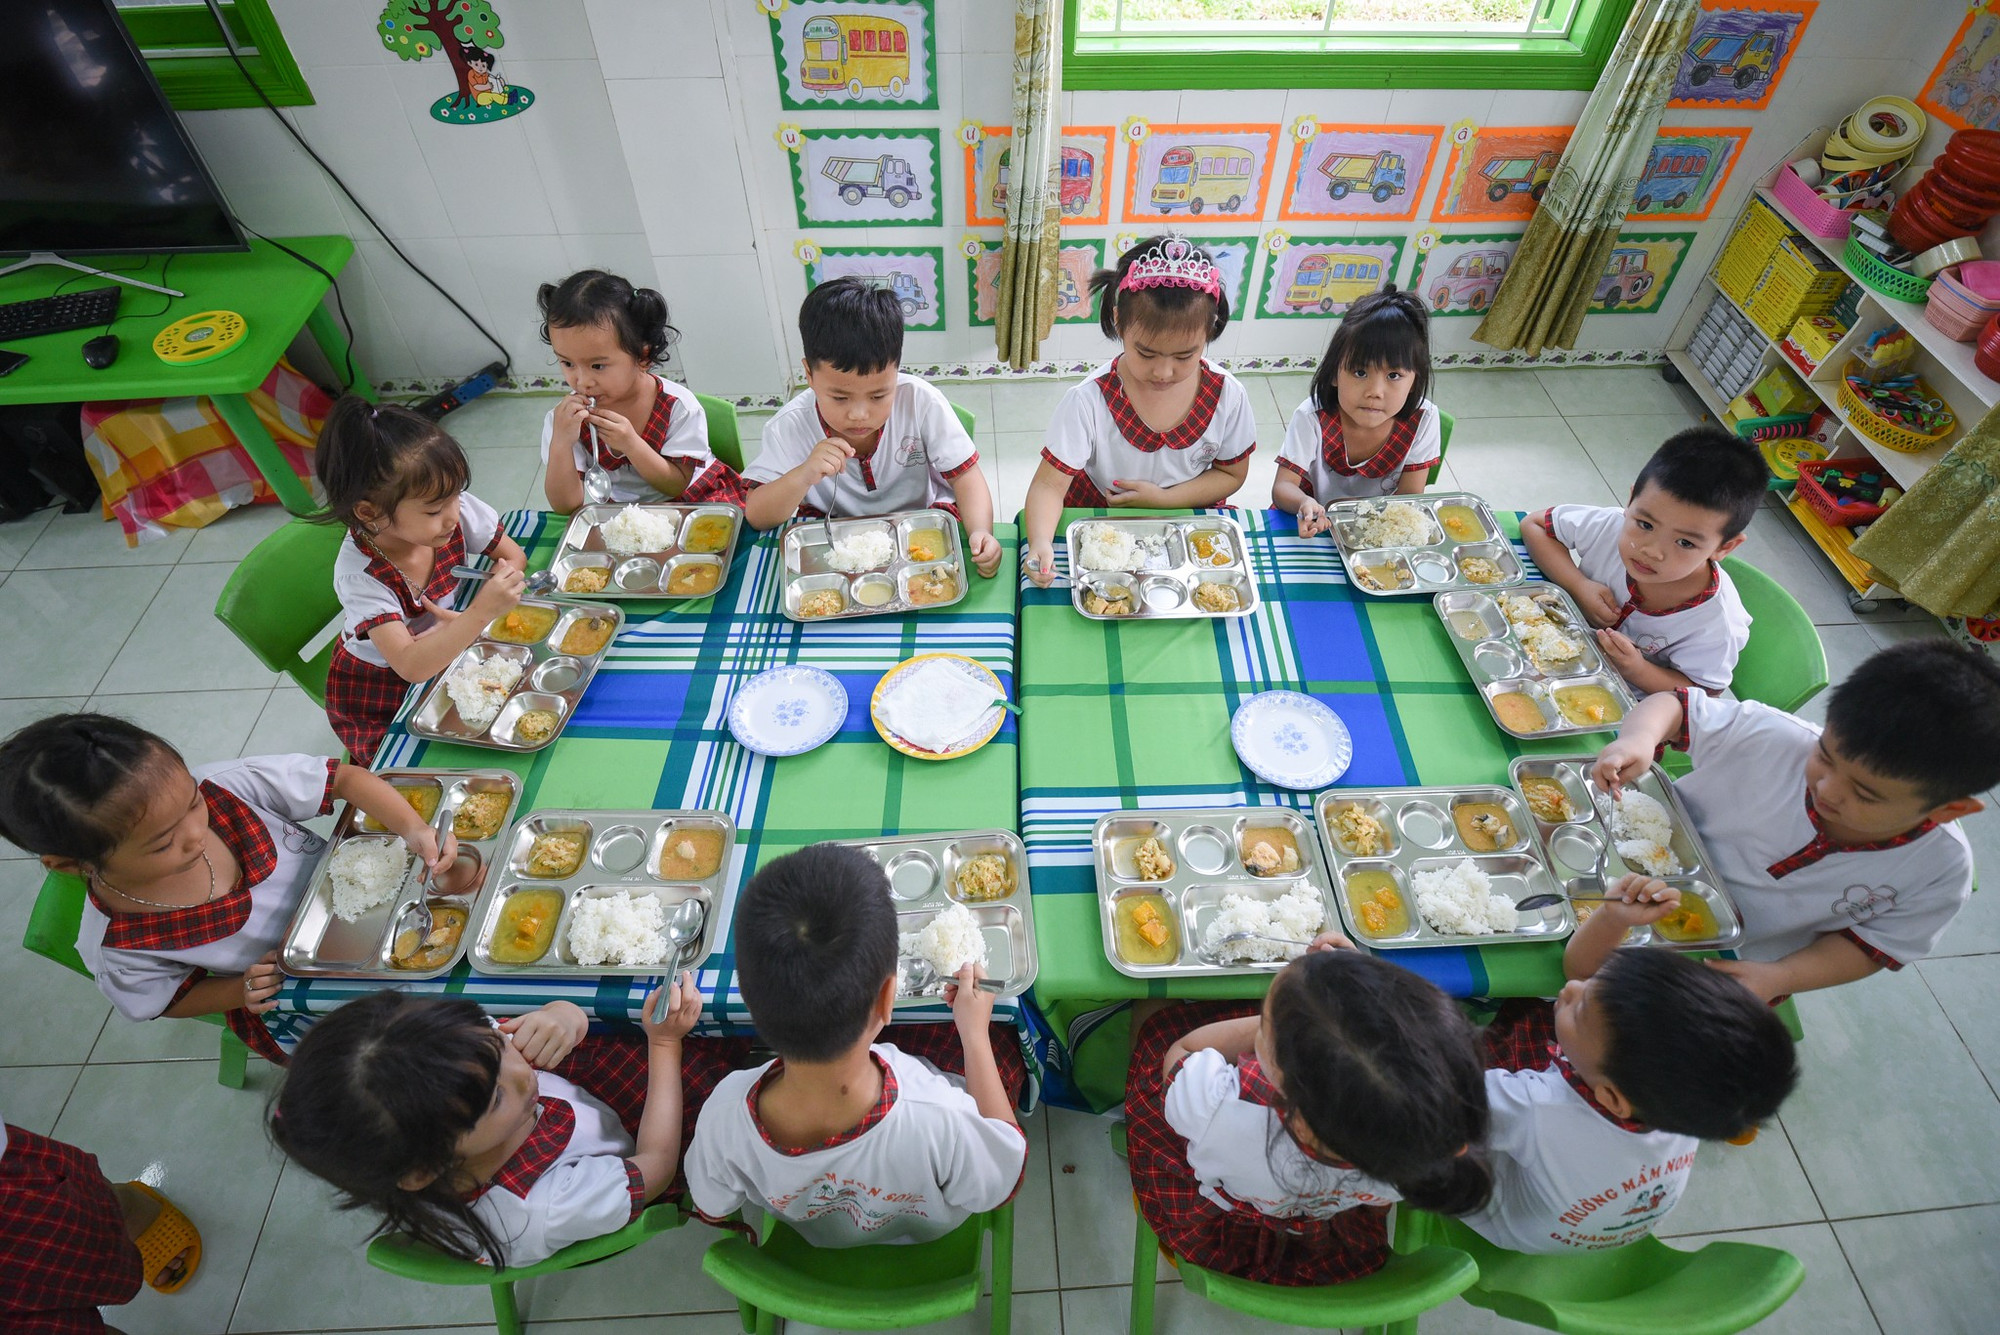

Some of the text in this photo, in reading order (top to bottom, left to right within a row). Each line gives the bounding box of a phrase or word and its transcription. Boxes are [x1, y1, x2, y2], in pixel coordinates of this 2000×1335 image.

[1132, 126, 1141, 136] a
[1300, 125, 1309, 135] n
[1458, 127, 1468, 140] â
[786, 133, 796, 144] u
[804, 248, 812, 259] h
[967, 242, 977, 255] ô
[1558, 1188, 1619, 1228] TRƯỜNG
[1621, 1164, 1662, 1194] MẦM
